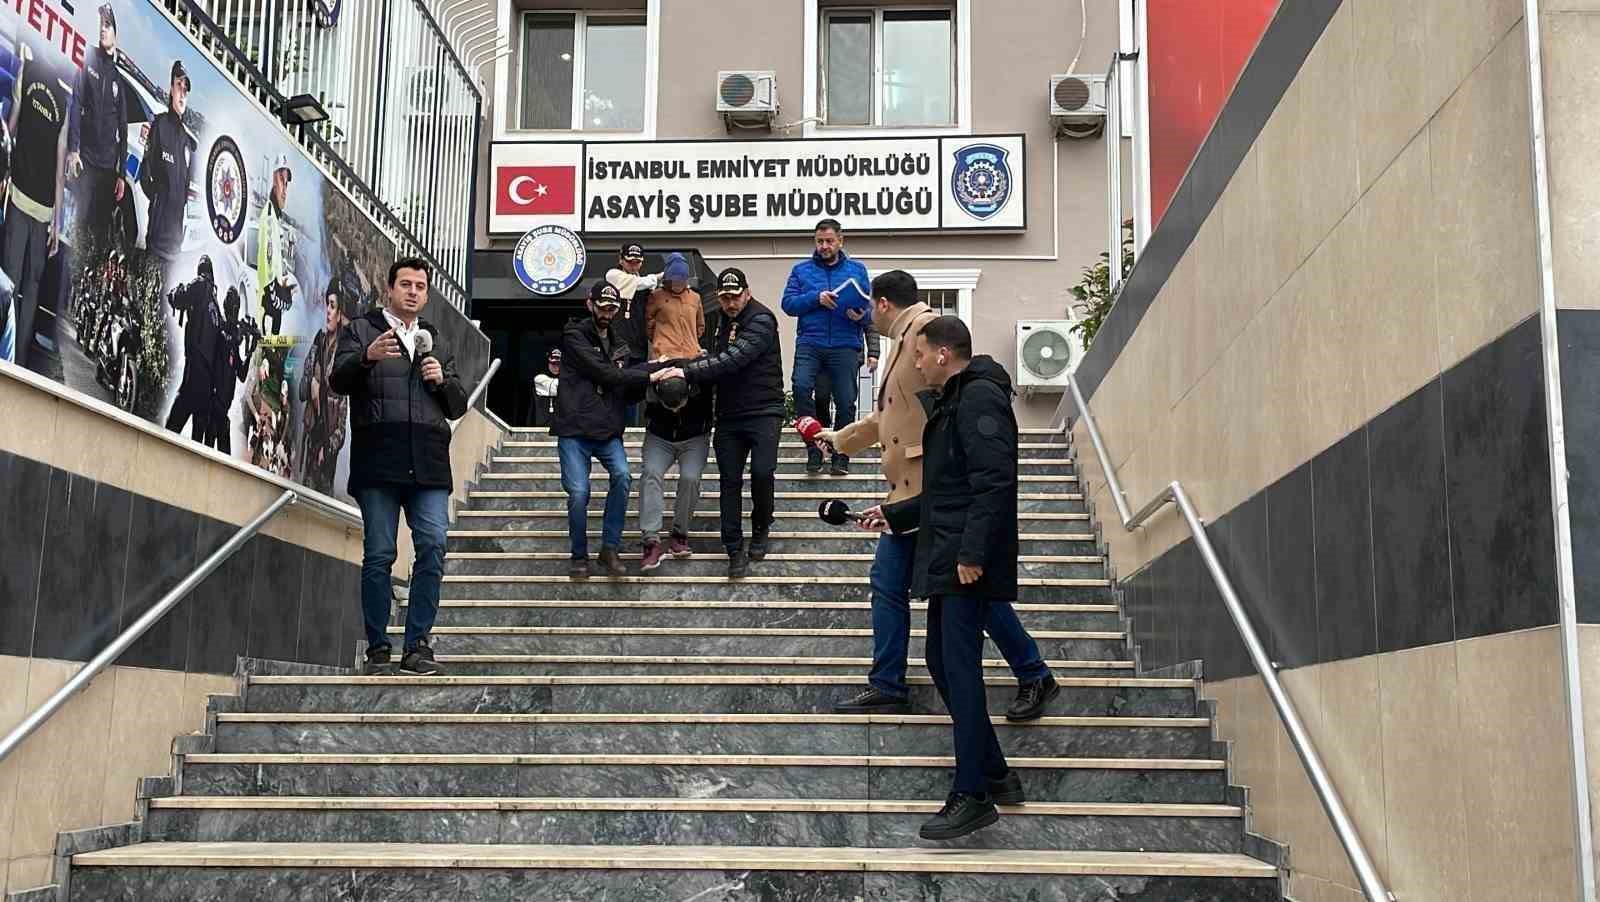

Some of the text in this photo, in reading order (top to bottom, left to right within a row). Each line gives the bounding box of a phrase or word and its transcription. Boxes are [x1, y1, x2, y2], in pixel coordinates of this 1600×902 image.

[588, 153, 930, 180] İSTANBUL EMNİYET MÜDÜRLÜĞÜ
[588, 187, 932, 223] ASAYİŞ ŞUBE MÜDÜRLÜĞÜ
